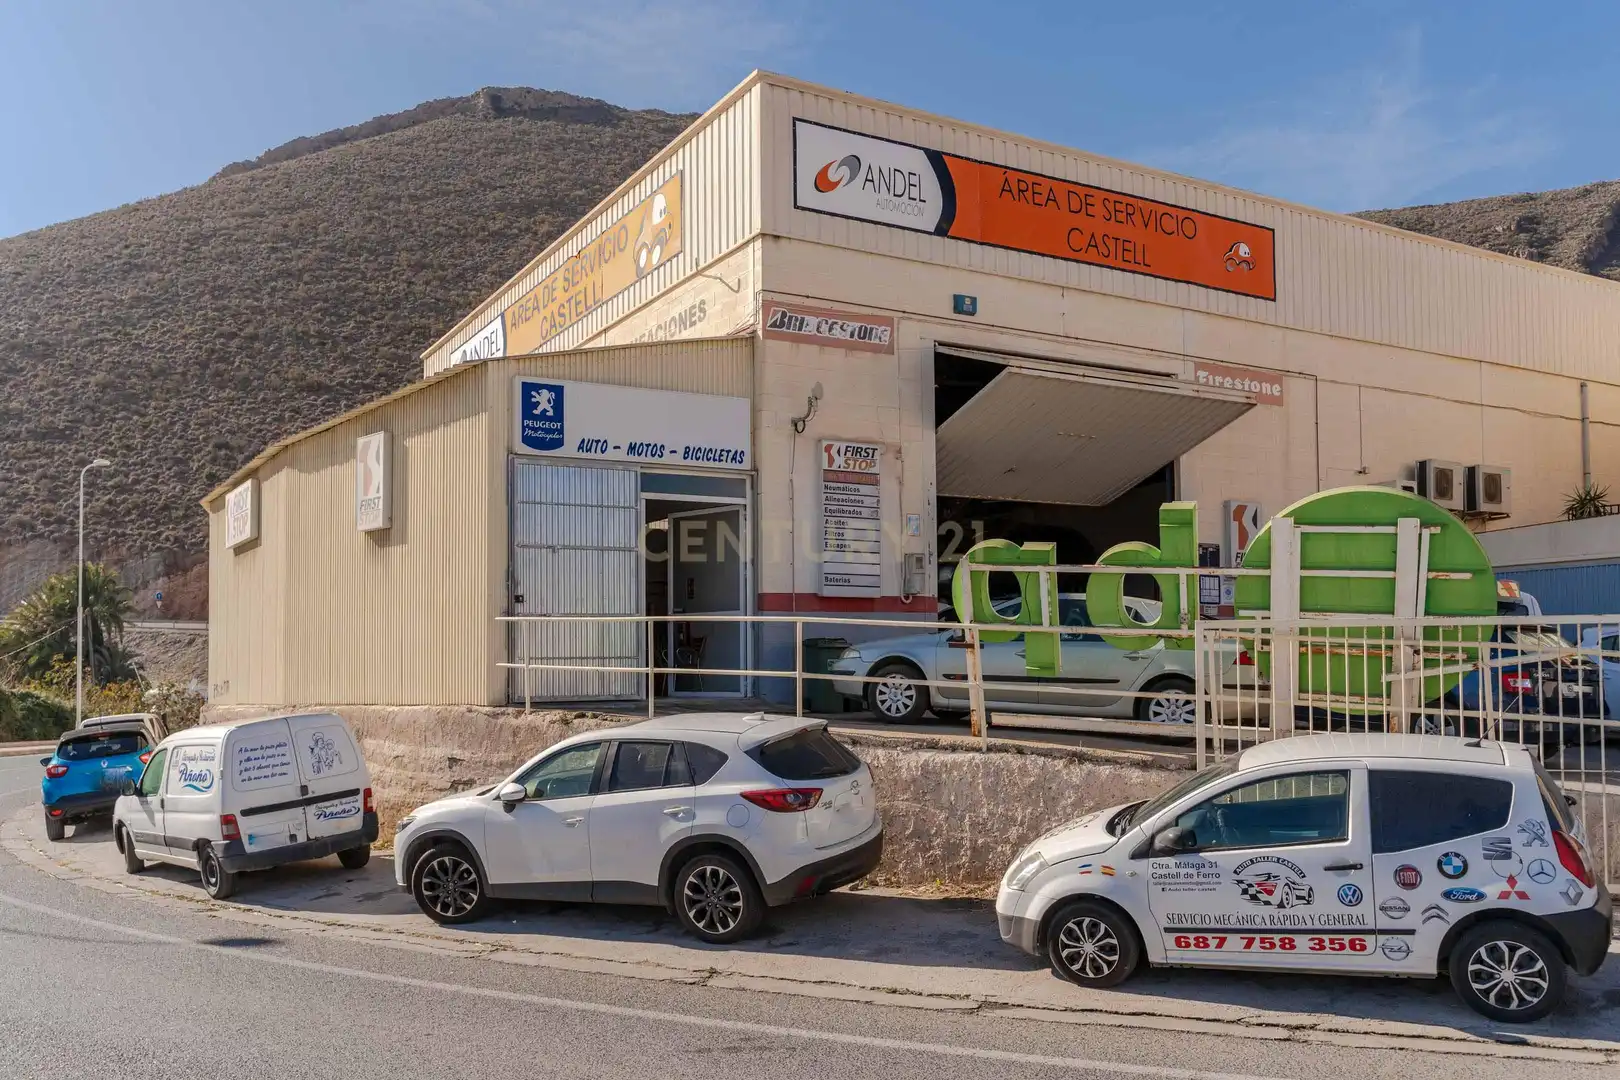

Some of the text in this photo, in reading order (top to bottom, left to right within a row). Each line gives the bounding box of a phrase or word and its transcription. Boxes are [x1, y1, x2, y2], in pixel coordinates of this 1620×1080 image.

[862, 163, 927, 203] ANDEL
[875, 198, 925, 217] AUTOMOCIÓN
[998, 171, 1197, 239] ÁREA DE SERVICIO
[1066, 227, 1152, 268] CASTELL
[542, 277, 558, 309] DE
[562, 223, 629, 293] SERVICIO
[540, 280, 603, 341] CASTELL
[1196, 370, 1282, 396] Firestone
[523, 419, 562, 430] PEUGEOT
[577, 437, 608, 454] AUTO
[626, 441, 665, 459] MOTOS
[682, 445, 745, 465] BICICLETAS
[843, 445, 878, 459] FIRST
[842, 458, 877, 471] STOP
[823, 483, 861, 493] Neumáticos
[824, 495, 864, 505] Alineaciones
[824, 507, 863, 516] Equilibrados
[1151, 861, 1218, 870] Ctra. Málaga 31
[1235, 855, 1305, 879] AUTO TALLER CASTELL
[1151, 871, 1221, 880] Castell de Ferro
[1400, 871, 1416, 884] FIAT
[1450, 890, 1478, 900] Ford
[1166, 911, 1369, 927] SERVICIO MECÁNICA RÁPIDA Y GENERAL
[1174, 935, 1367, 952] 687 758 356
